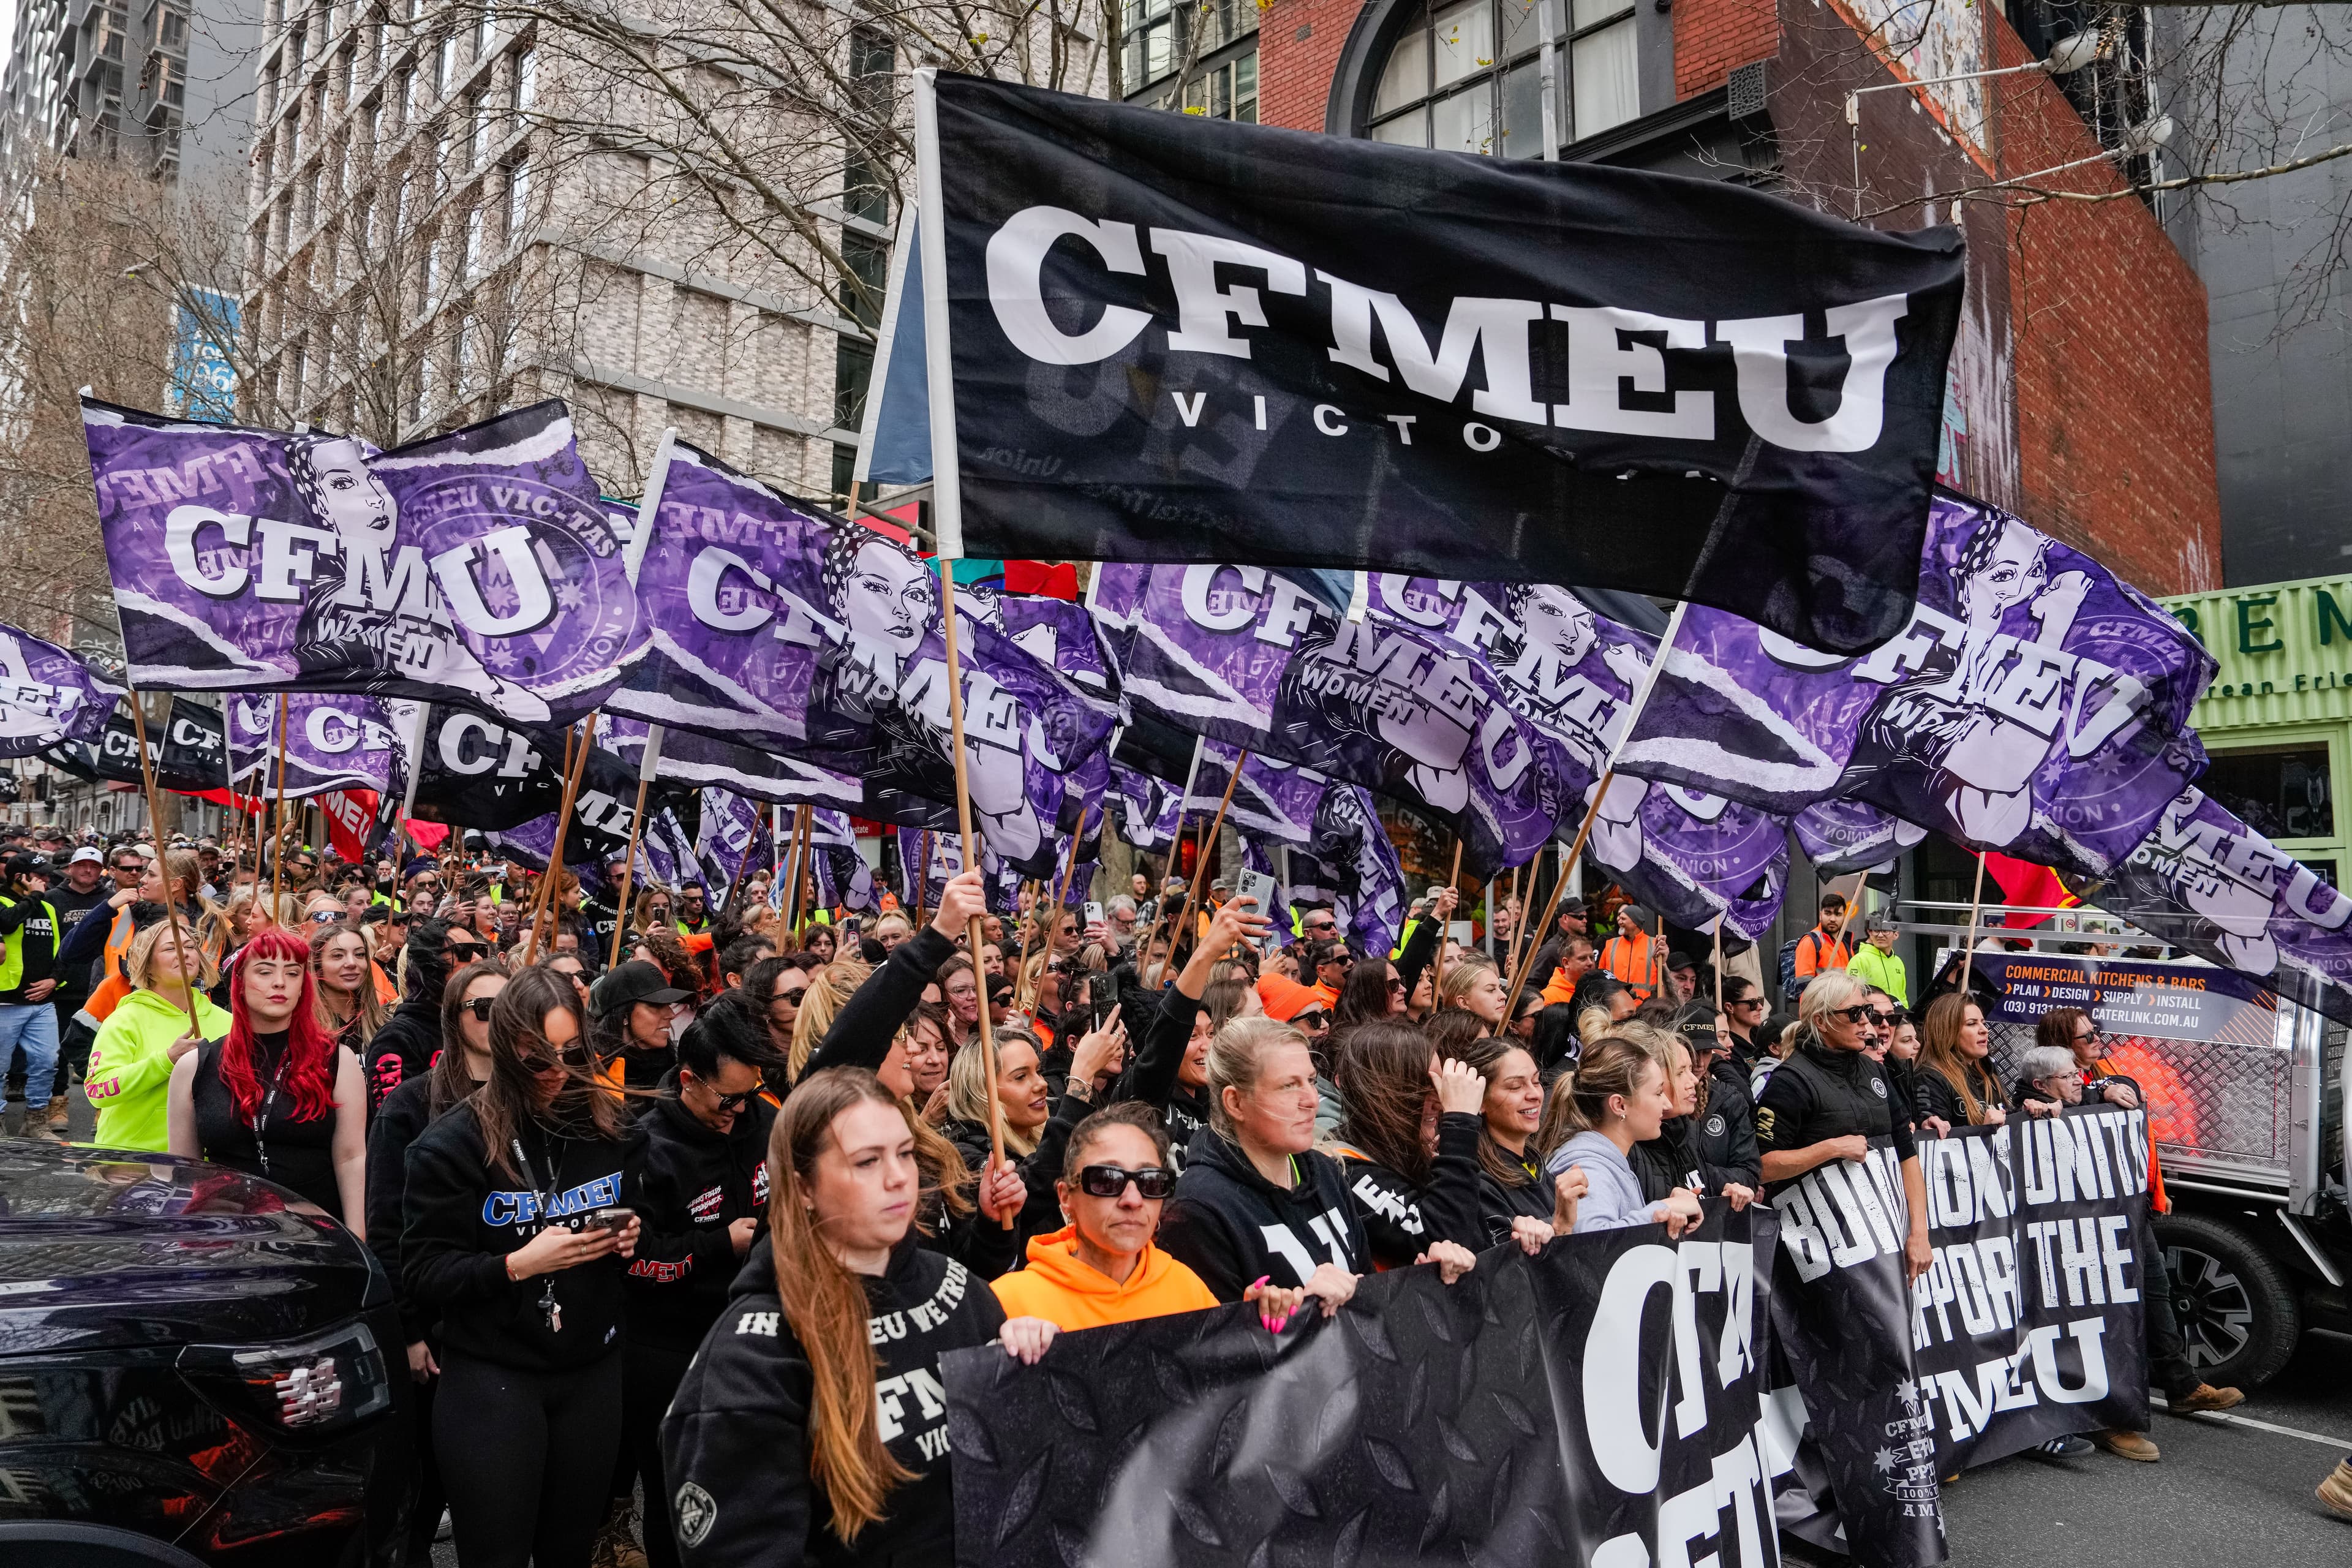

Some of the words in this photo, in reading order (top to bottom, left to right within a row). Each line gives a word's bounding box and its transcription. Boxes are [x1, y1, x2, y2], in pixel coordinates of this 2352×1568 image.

[986, 206, 1908, 452] CFMEU
[491, 486, 616, 558] VIC-TAS
[164, 505, 558, 636] CFMU
[1301, 665, 1415, 726] WOMEN
[2207, 681, 2274, 698] rean
[2005, 965, 2084, 984] COMMERCIAL
[2089, 971, 2153, 989] KITCHENS
[2156, 975, 2165, 990] &
[2170, 976, 2206, 992] BARS
[2013, 983, 2040, 997] PLAN
[2052, 986, 2090, 1001] DESIGN
[2102, 990, 2143, 1005] SUPPLY
[2157, 995, 2201, 1010] INSTALL
[1683, 1023, 1714, 1032] CFMEU
[2003, 1000, 2026, 1013] (03)
[2092, 1008, 2199, 1028] CATERLINK.COM.AU
[694, 1212, 720, 1223] CFMEU
[2028, 1215, 2140, 1308] THE
[736, 1312, 780, 1337] IN
[908, 1299, 948, 1333] WE
[1903, 1487, 1933, 1499] 100%
